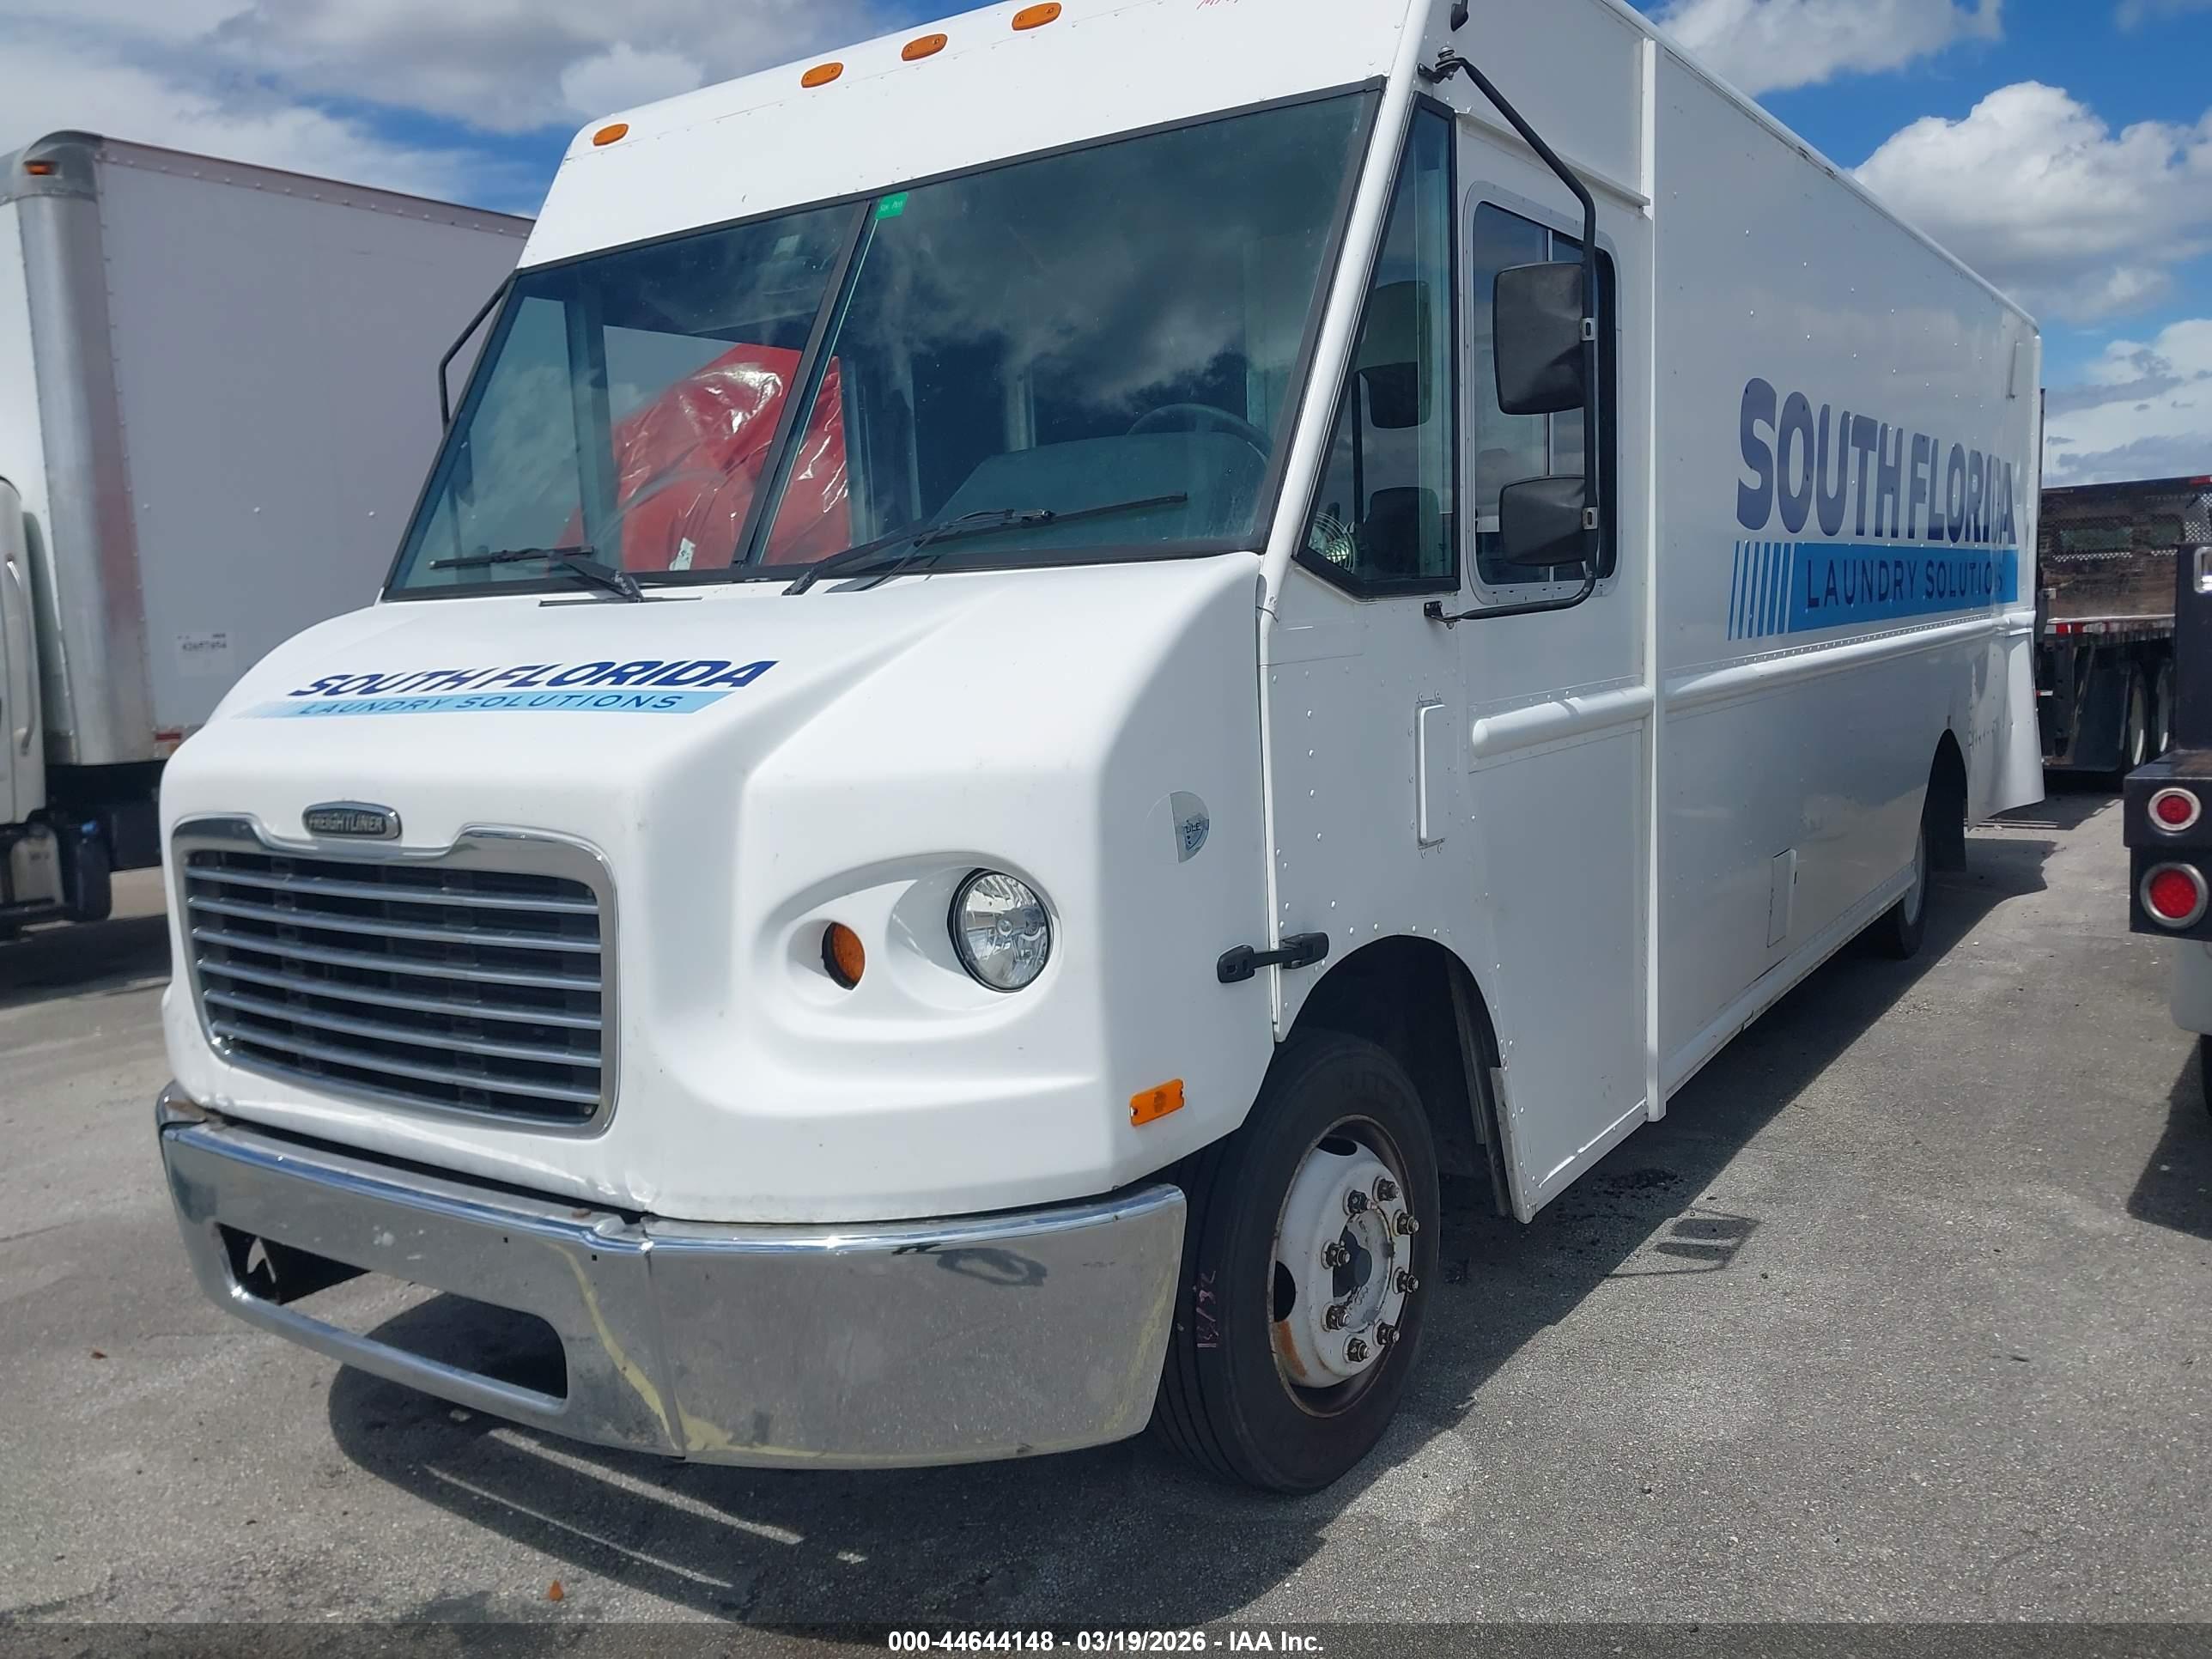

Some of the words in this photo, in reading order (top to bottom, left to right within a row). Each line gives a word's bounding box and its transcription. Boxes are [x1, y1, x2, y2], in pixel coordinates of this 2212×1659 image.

[1736, 377, 1904, 538] SOUTH
[1907, 432, 2016, 544] FLORIDA
[1807, 558, 1918, 609] LAUNDRY
[1925, 559, 2003, 599] SOLUTIOS
[287, 666, 501, 696] SOUTH
[466, 659, 780, 690] FLORIDA
[298, 697, 453, 715] LAUNDRY
[455, 694, 684, 709] SOLUTIONS
[308, 811, 384, 832] FREIGHTLINER
